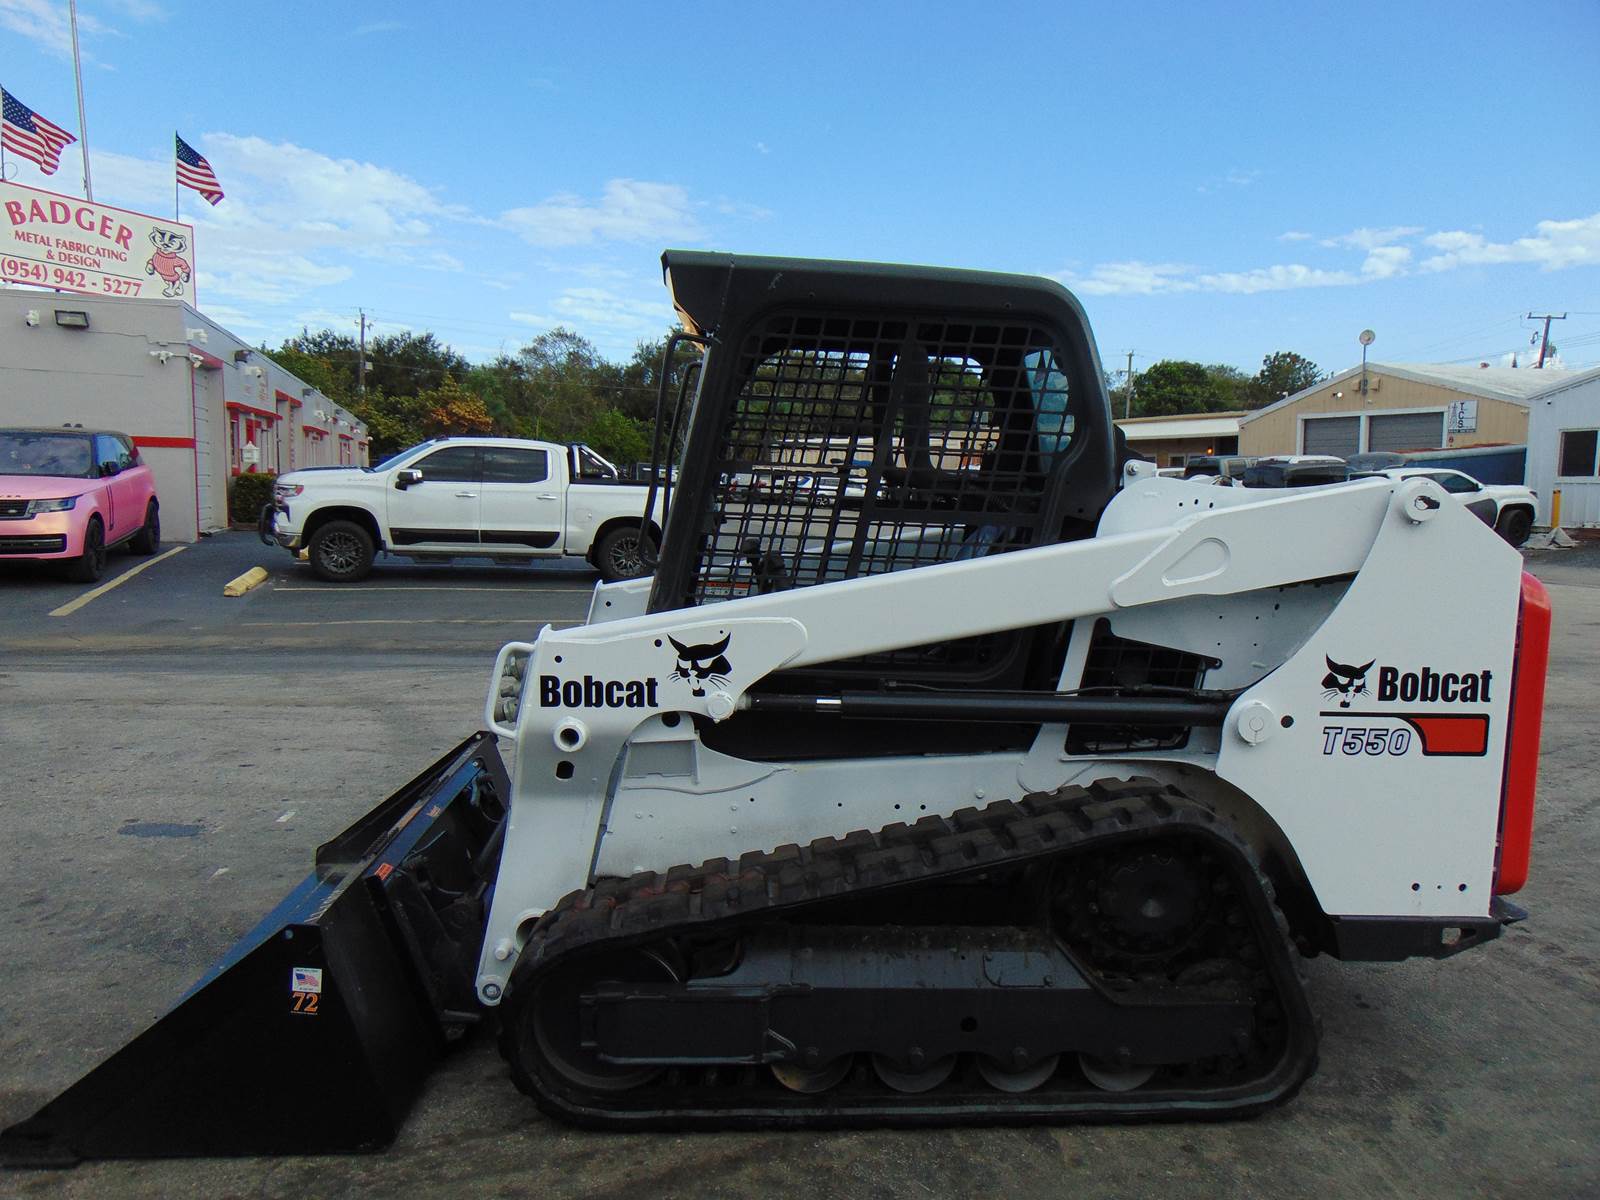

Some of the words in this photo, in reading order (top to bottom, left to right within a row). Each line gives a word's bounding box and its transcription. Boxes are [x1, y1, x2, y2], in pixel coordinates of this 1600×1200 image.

[5, 199, 133, 251] BADGER
[14, 230, 52, 247] METAL
[56, 238, 128, 262] FABRICATING
[46, 250, 55, 260] &
[58, 252, 101, 269] DESIGN
[1, 256, 48, 282] (954)
[53, 268, 87, 288] 942
[103, 277, 143, 297] 5277
[539, 675, 659, 708] Bobcat
[1378, 666, 1492, 703] Bobcat
[1323, 726, 1411, 756] T550
[292, 992, 319, 1012] 72
